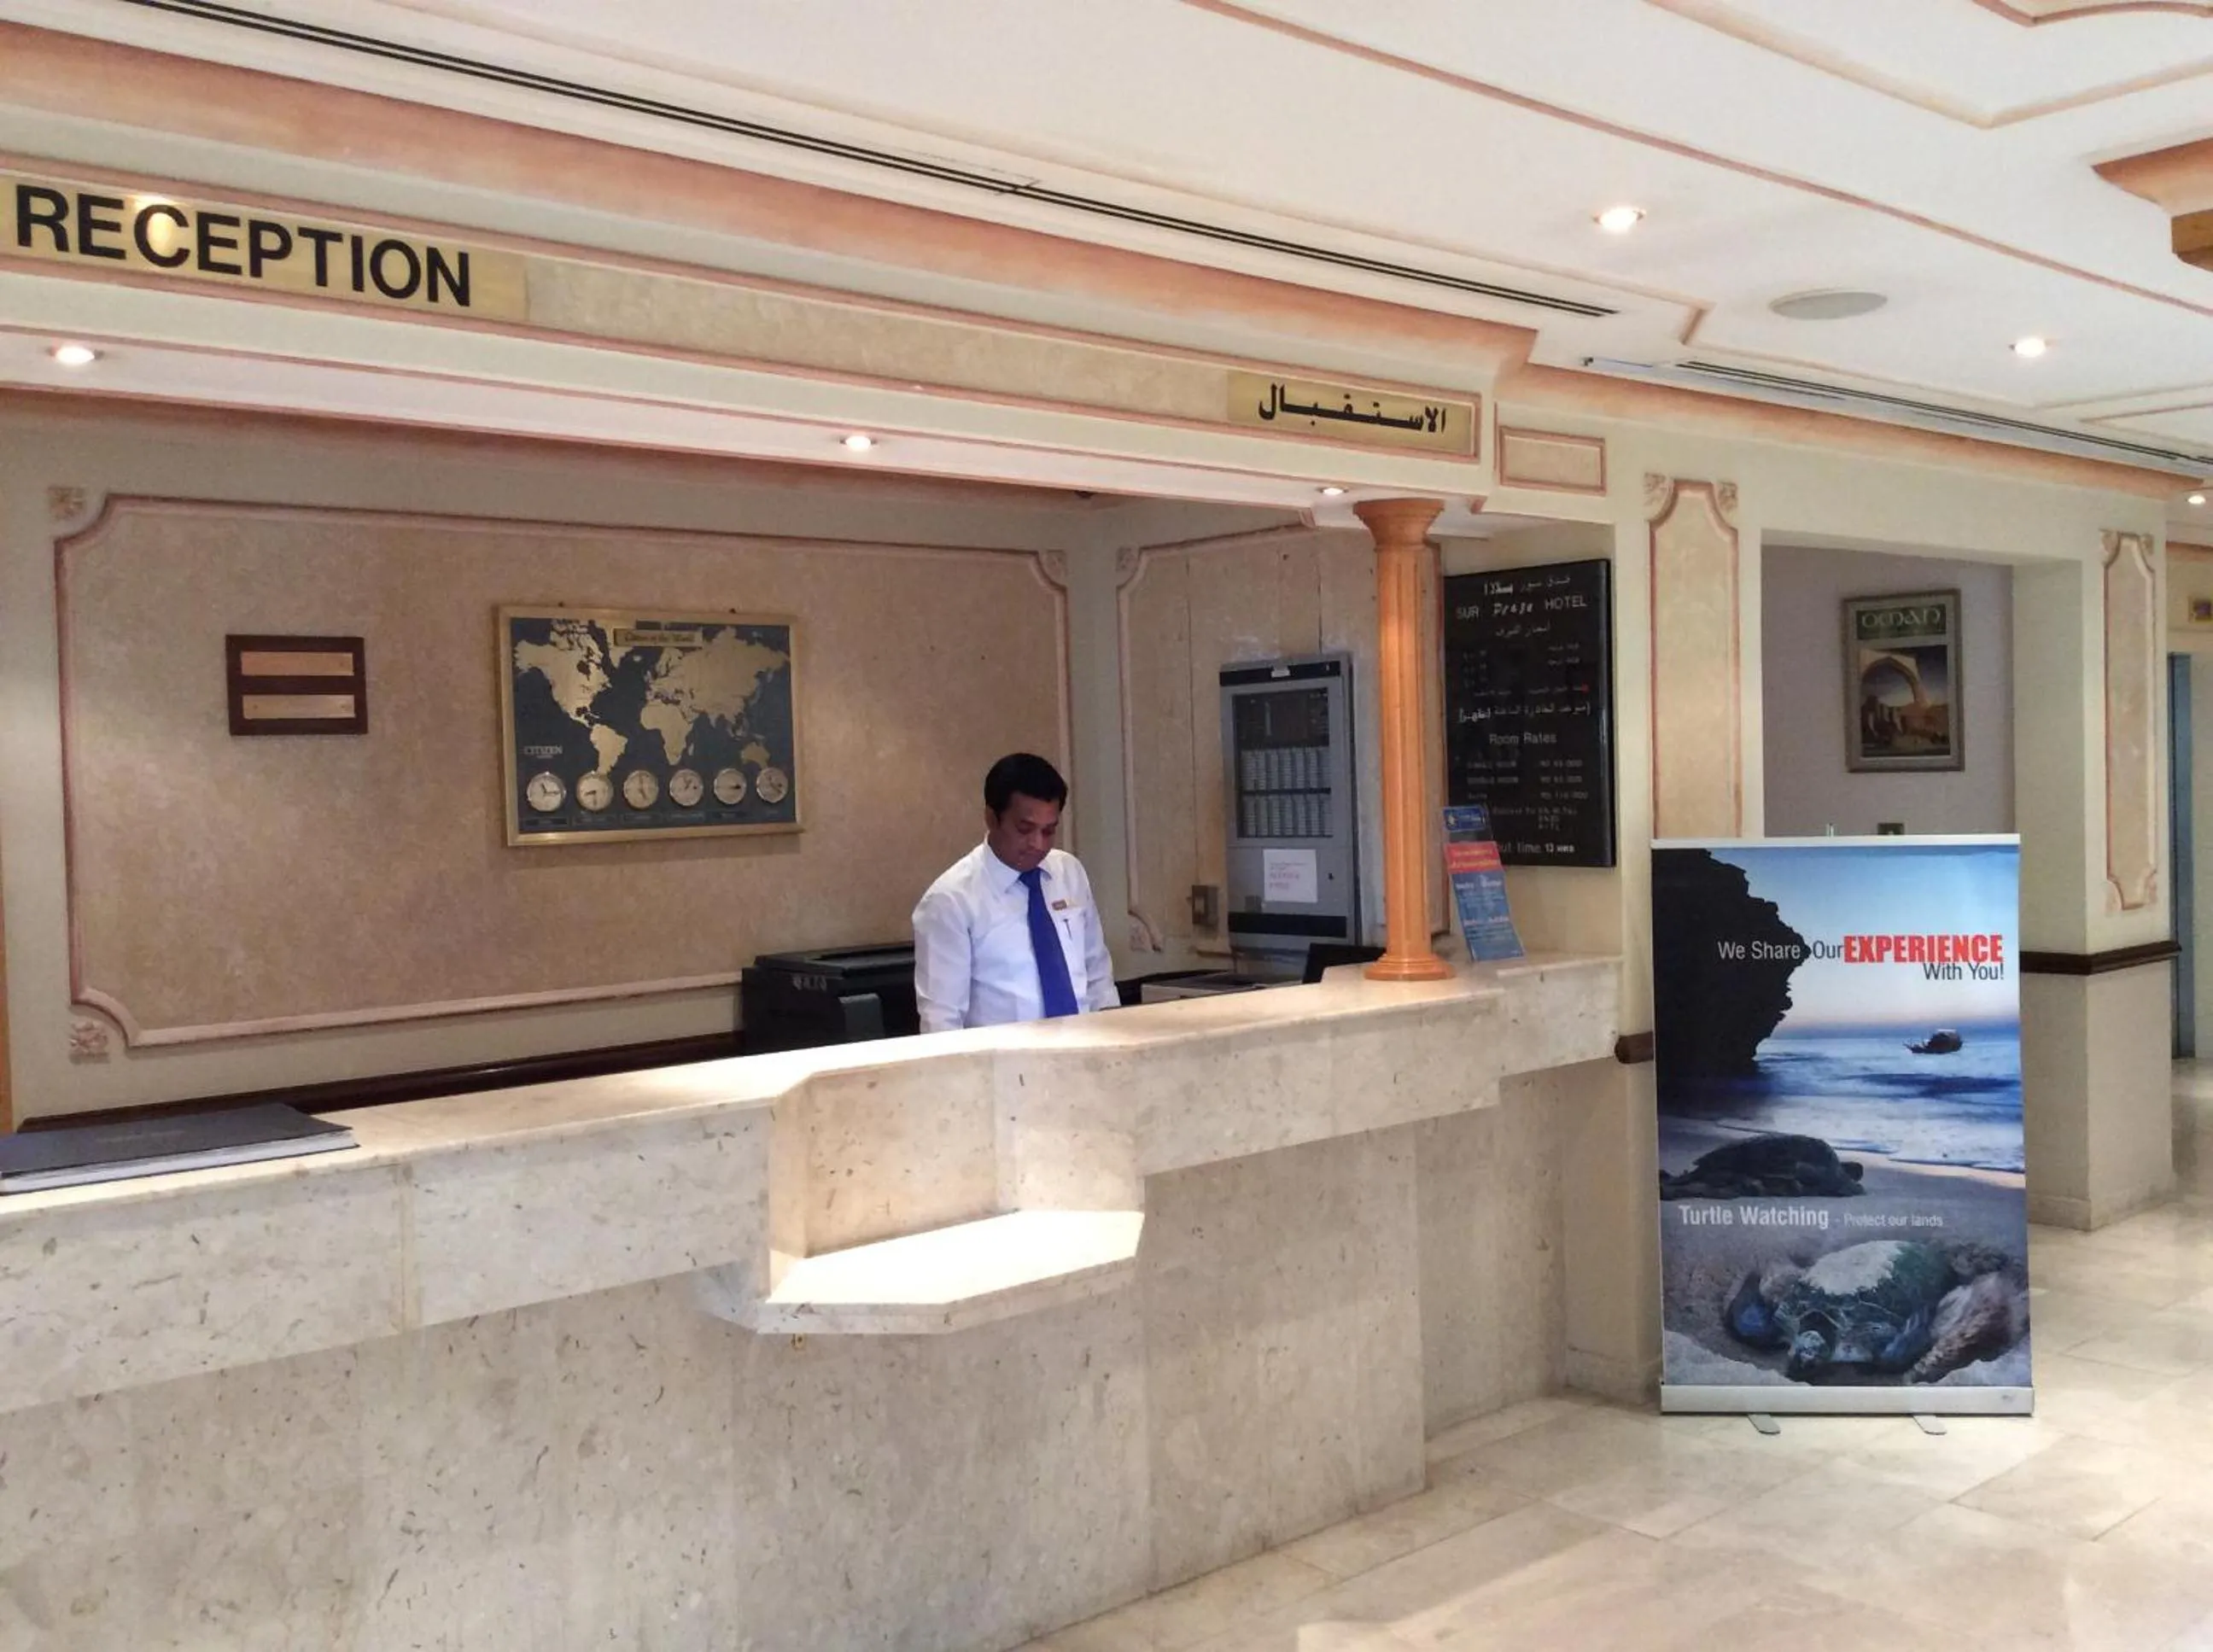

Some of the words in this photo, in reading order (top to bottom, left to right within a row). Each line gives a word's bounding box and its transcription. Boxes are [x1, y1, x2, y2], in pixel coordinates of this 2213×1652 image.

[15, 184, 471, 307] RECEPTION
[1258, 382, 1446, 434] الاستقبال
[1544, 594, 1588, 610] HOTEL
[1523, 732, 1557, 744] Rates
[1718, 941, 1745, 960] We
[1751, 941, 1801, 960] Share
[1813, 941, 1842, 960] Our
[1843, 935, 2004, 963] EXPERIENCE
[1924, 963, 1963, 981] With
[1969, 963, 2004, 981] You!
[1679, 1205, 1733, 1226] Turtle
[1739, 1205, 1829, 1229] Watching
[1843, 1212, 1887, 1227] Protect
[1888, 1215, 1907, 1227] our
[1911, 1212, 1943, 1227] lands
